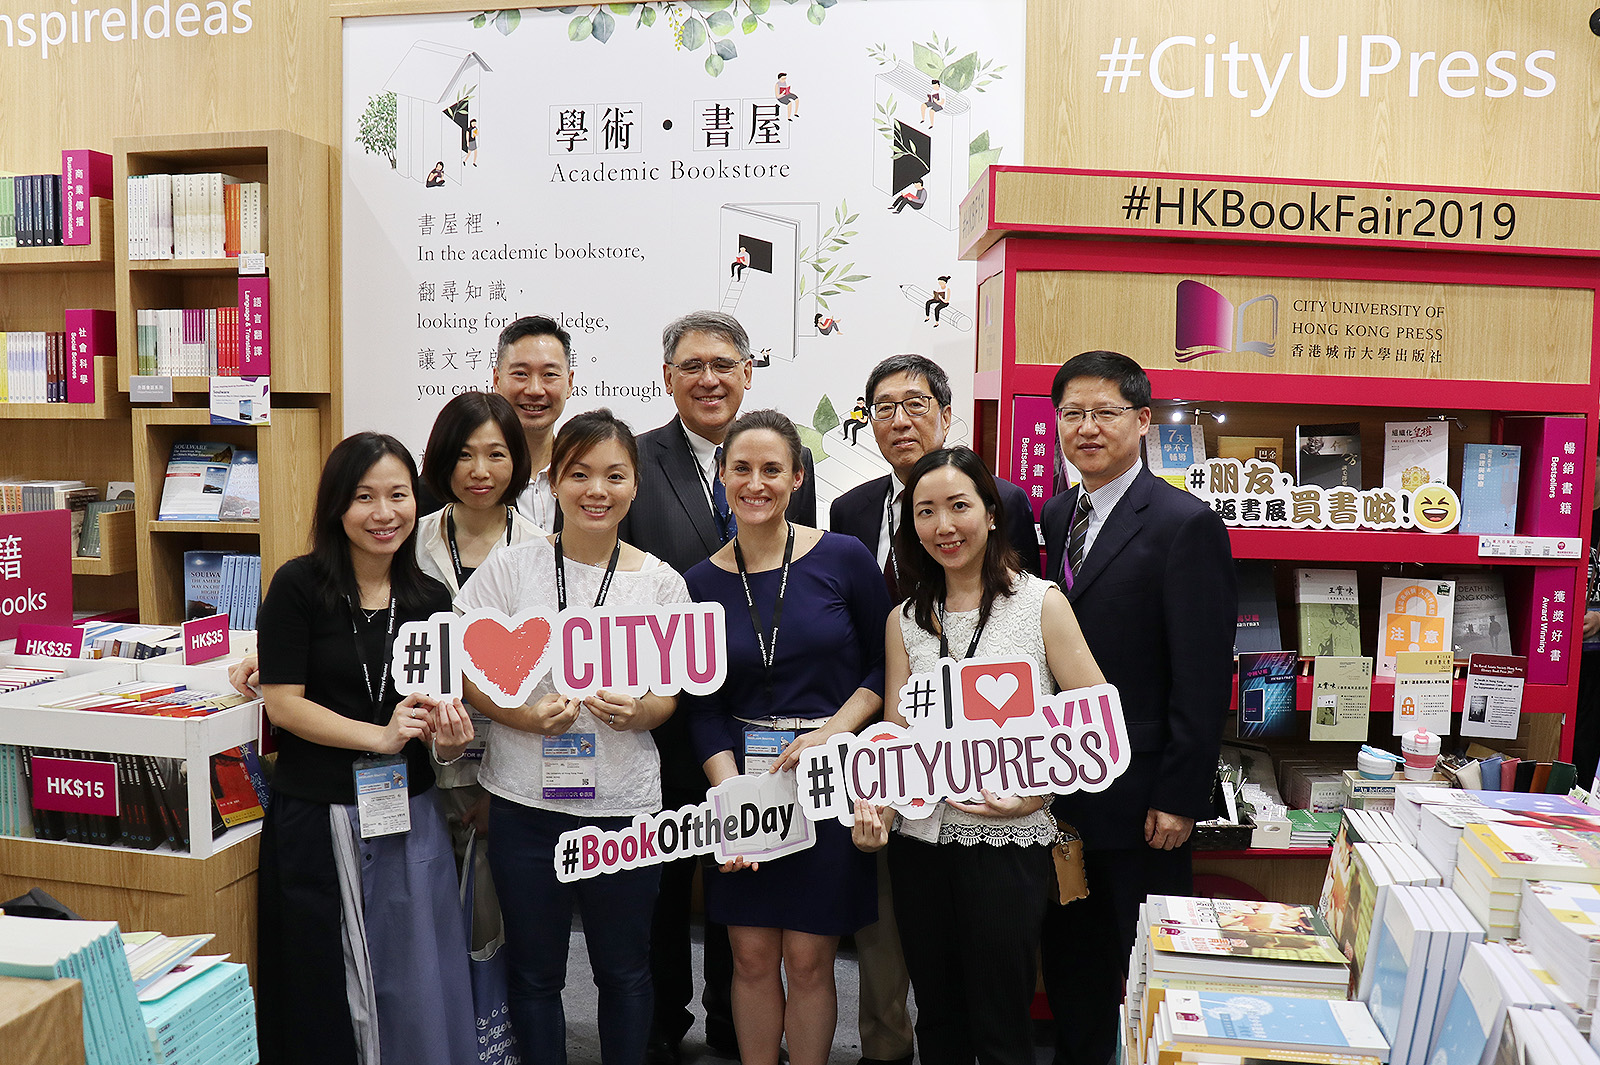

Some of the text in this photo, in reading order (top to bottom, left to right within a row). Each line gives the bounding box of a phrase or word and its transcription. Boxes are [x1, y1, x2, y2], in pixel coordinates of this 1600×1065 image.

[1096, 34, 1557, 118] #CityUPress
[549, 159, 791, 183] Academic Bookstore
[1122, 185, 1517, 241] #HKBookFair2019
[417, 243, 646, 264] In the academic bookstore,
[417, 313, 478, 334] looking
[484, 313, 509, 329] for
[1293, 300, 1445, 319] CITY UNIVERSITY OF
[1292, 322, 1443, 341] HONG KONG PRESS
[79, 327, 88, 384] 社會科學
[1291, 344, 1442, 363] 香港城市大學出版社
[417, 384, 446, 401] you
[451, 384, 479, 396] can
[594, 381, 662, 404] through
[1020, 437, 1030, 481] Bestsellers
[1031, 421, 1047, 498] 暢銷書籍
[1548, 456, 1559, 499] Bestsellers
[1559, 441, 1576, 515] 暢銷書籍
[0, 587, 47, 617] ooks
[1459, 585, 1482, 593] DEATH
[191, 629, 224, 649] HK$35
[1537, 596, 1550, 653] Award Winning
[1550, 591, 1566, 661] 獲獎好書
[26, 639, 72, 657] HK$35
[403, 612, 717, 696] #I CITYU
[852, 730, 1108, 801] CITYUPRESS
[47, 776, 104, 799] HK$15
[562, 802, 794, 875] #BookOftheDay
